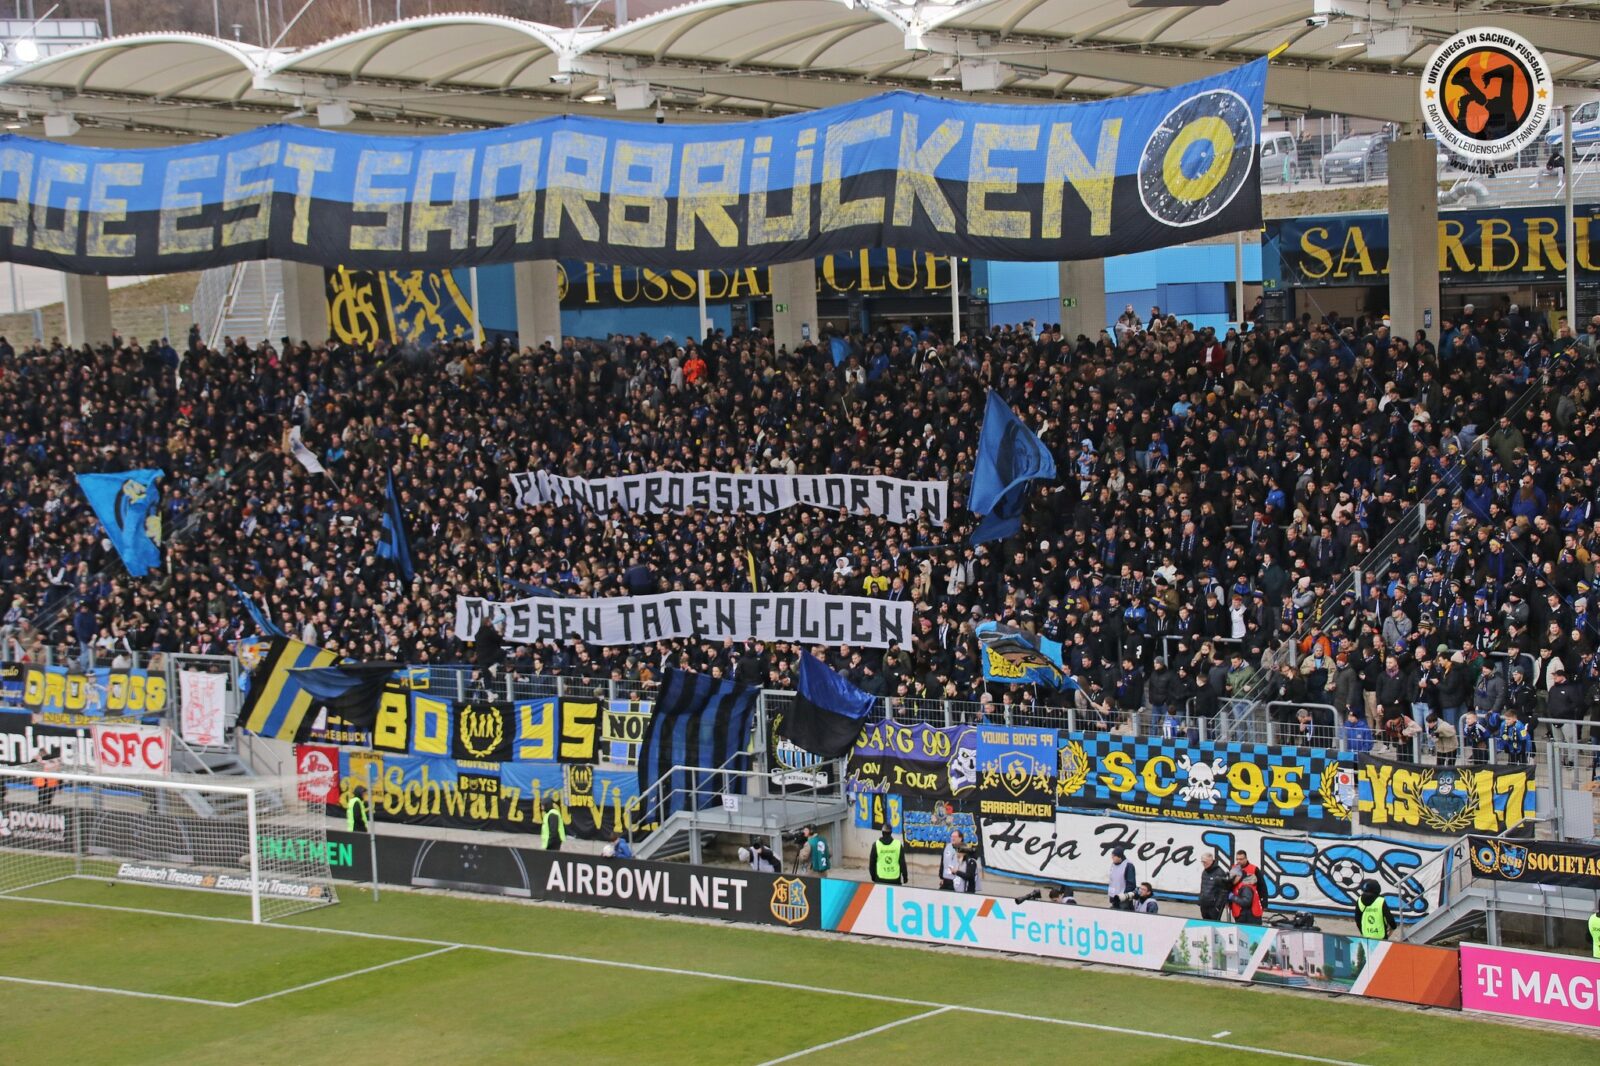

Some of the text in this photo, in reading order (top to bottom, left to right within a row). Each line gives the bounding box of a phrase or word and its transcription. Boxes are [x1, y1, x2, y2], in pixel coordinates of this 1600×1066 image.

[158, 140, 335, 256] EST
[350, 110, 1122, 252] SAARBRÜCKEN
[624, 474, 780, 513] GROSSEN
[793, 477, 941, 521] WORTEN
[617, 598, 736, 641] TATEN
[751, 597, 902, 643] FOLGEN
[101, 731, 164, 769] SFC
[922, 730, 951, 757] 99
[981, 732, 1053, 746] YOUNG BOYS 99
[862, 762, 938, 791] ON TOUR
[1099, 751, 1305, 809] SC 95
[1366, 765, 1527, 832] YS 17
[980, 800, 1053, 817] SAARBRÜCKEN
[1116, 803, 1160, 816] VIEILLE
[1163, 810, 1200, 820] GARDE
[983, 815, 1082, 872] Heja
[1094, 822, 1197, 879] Heja
[118, 863, 167, 878] Eisenbach
[546, 860, 748, 911] AIRBOWL.NET
[886, 888, 1143, 956] laux Fertigbau
